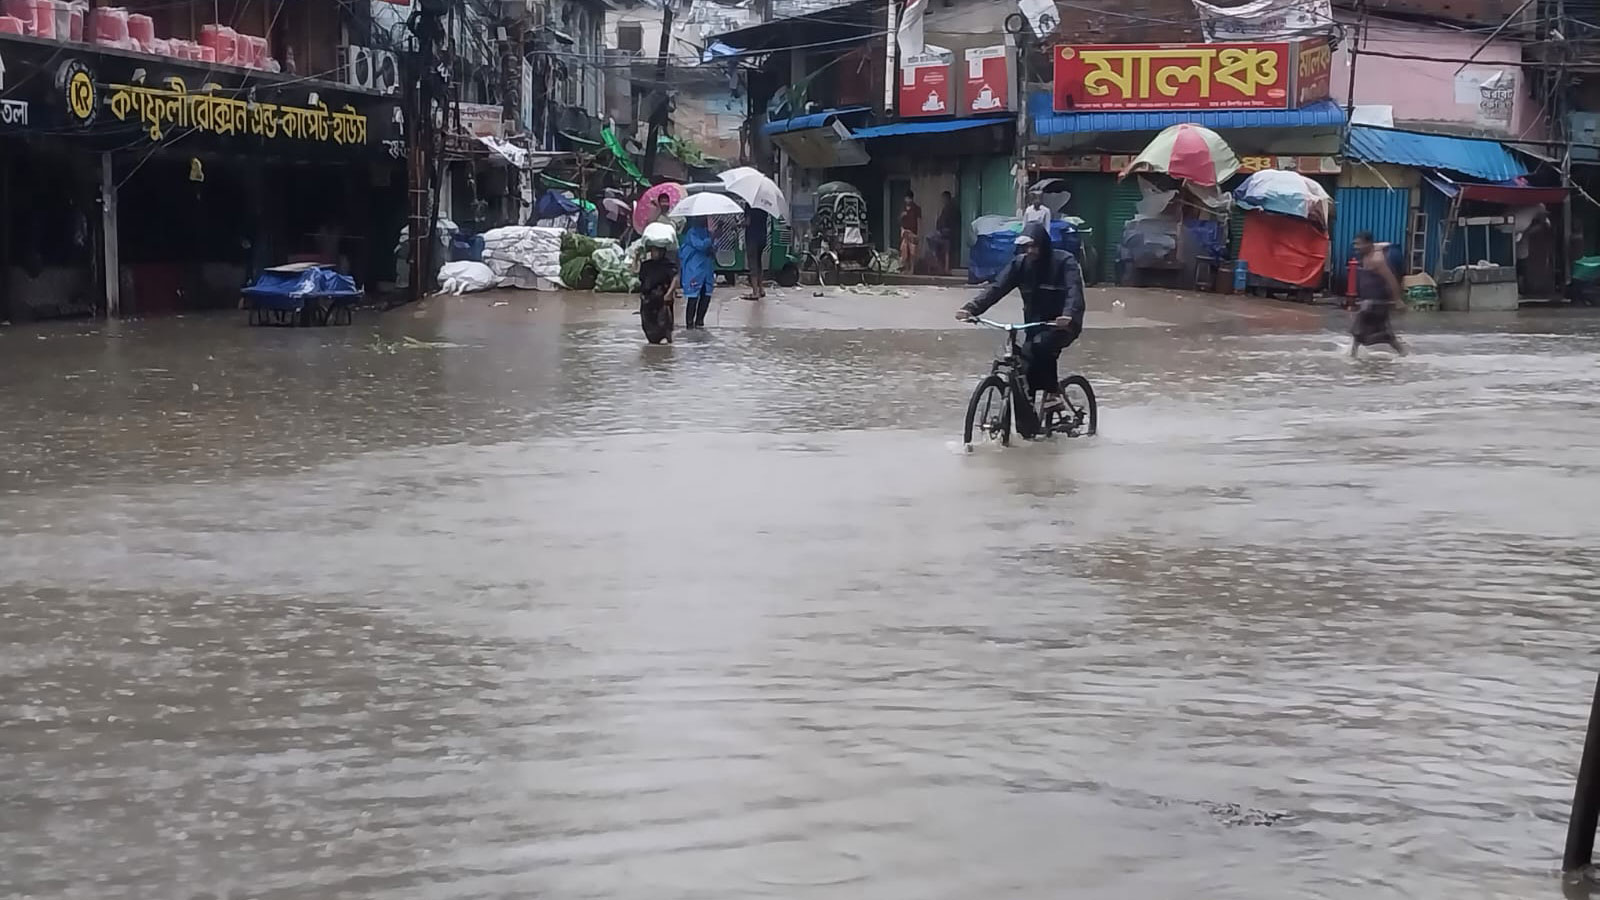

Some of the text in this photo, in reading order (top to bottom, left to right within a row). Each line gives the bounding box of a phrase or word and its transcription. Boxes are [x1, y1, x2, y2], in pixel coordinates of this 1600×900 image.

[1079, 48, 1278, 99] মালঞ্চ
[251, 102, 278, 139] এন্ড
[332, 103, 367, 145] হাউস
